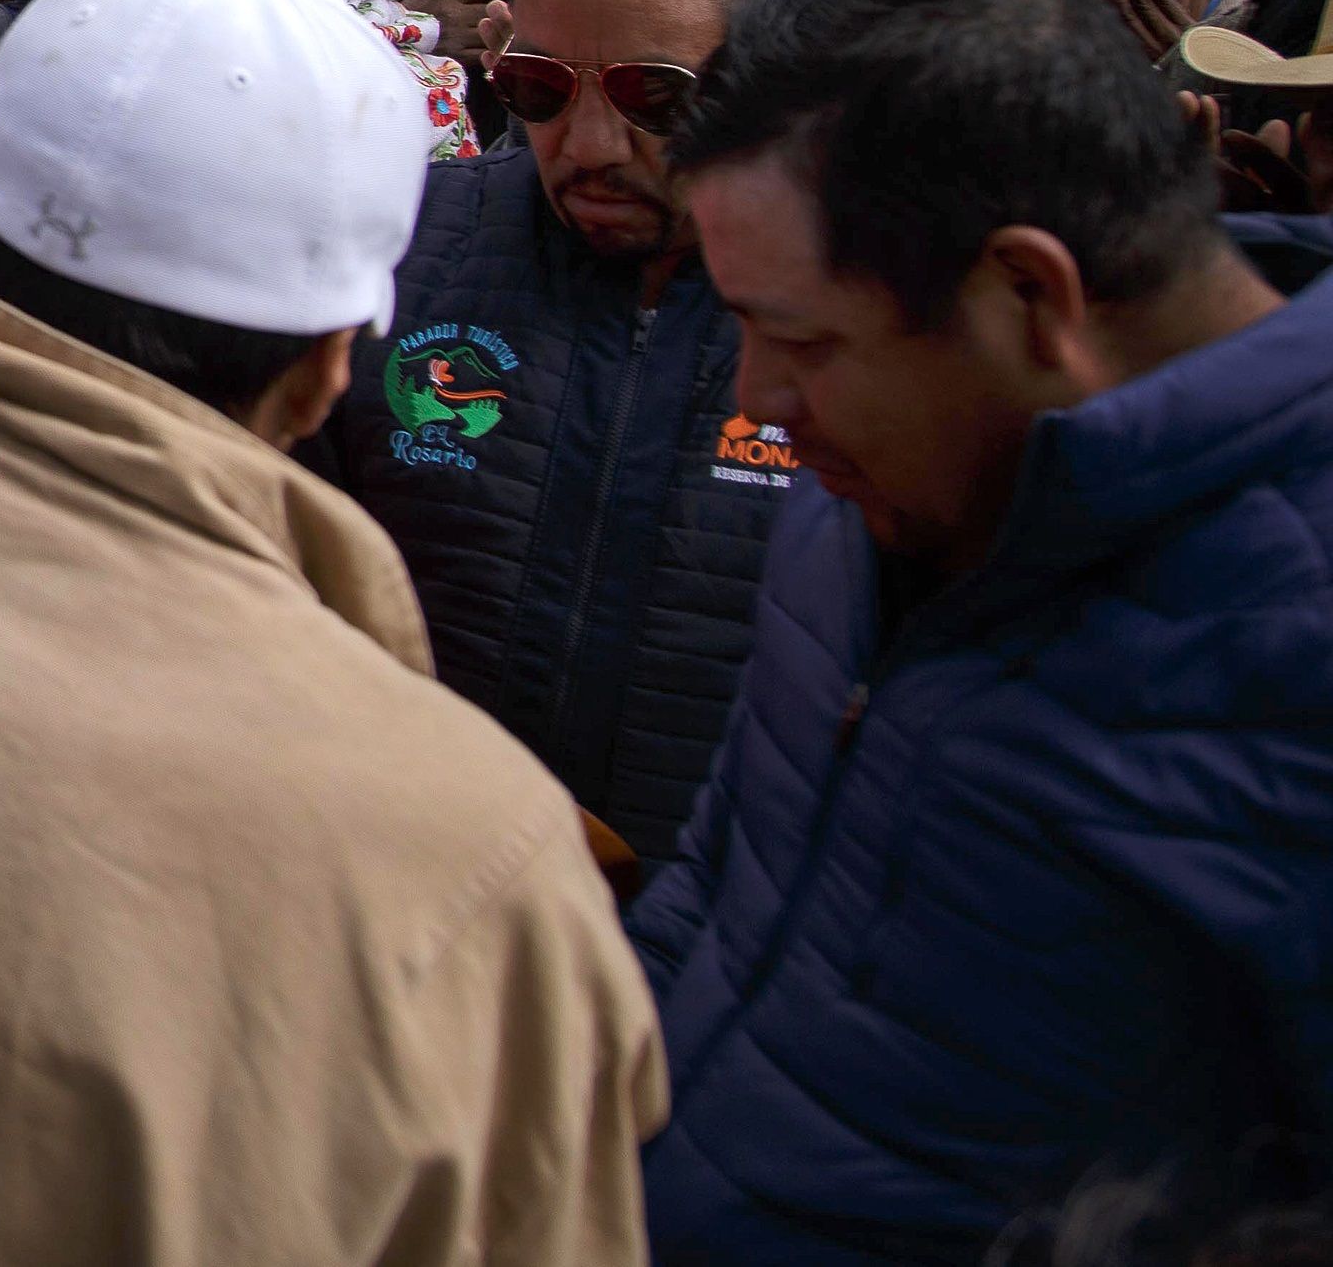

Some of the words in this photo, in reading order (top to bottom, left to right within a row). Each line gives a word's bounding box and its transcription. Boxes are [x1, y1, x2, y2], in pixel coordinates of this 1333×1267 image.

[398, 323, 459, 352] PARADOR
[389, 430, 477, 470] Rosario
[717, 437, 800, 469] MON
[710, 464, 769, 486] RESERVA
[769, 473, 791, 488] DE
